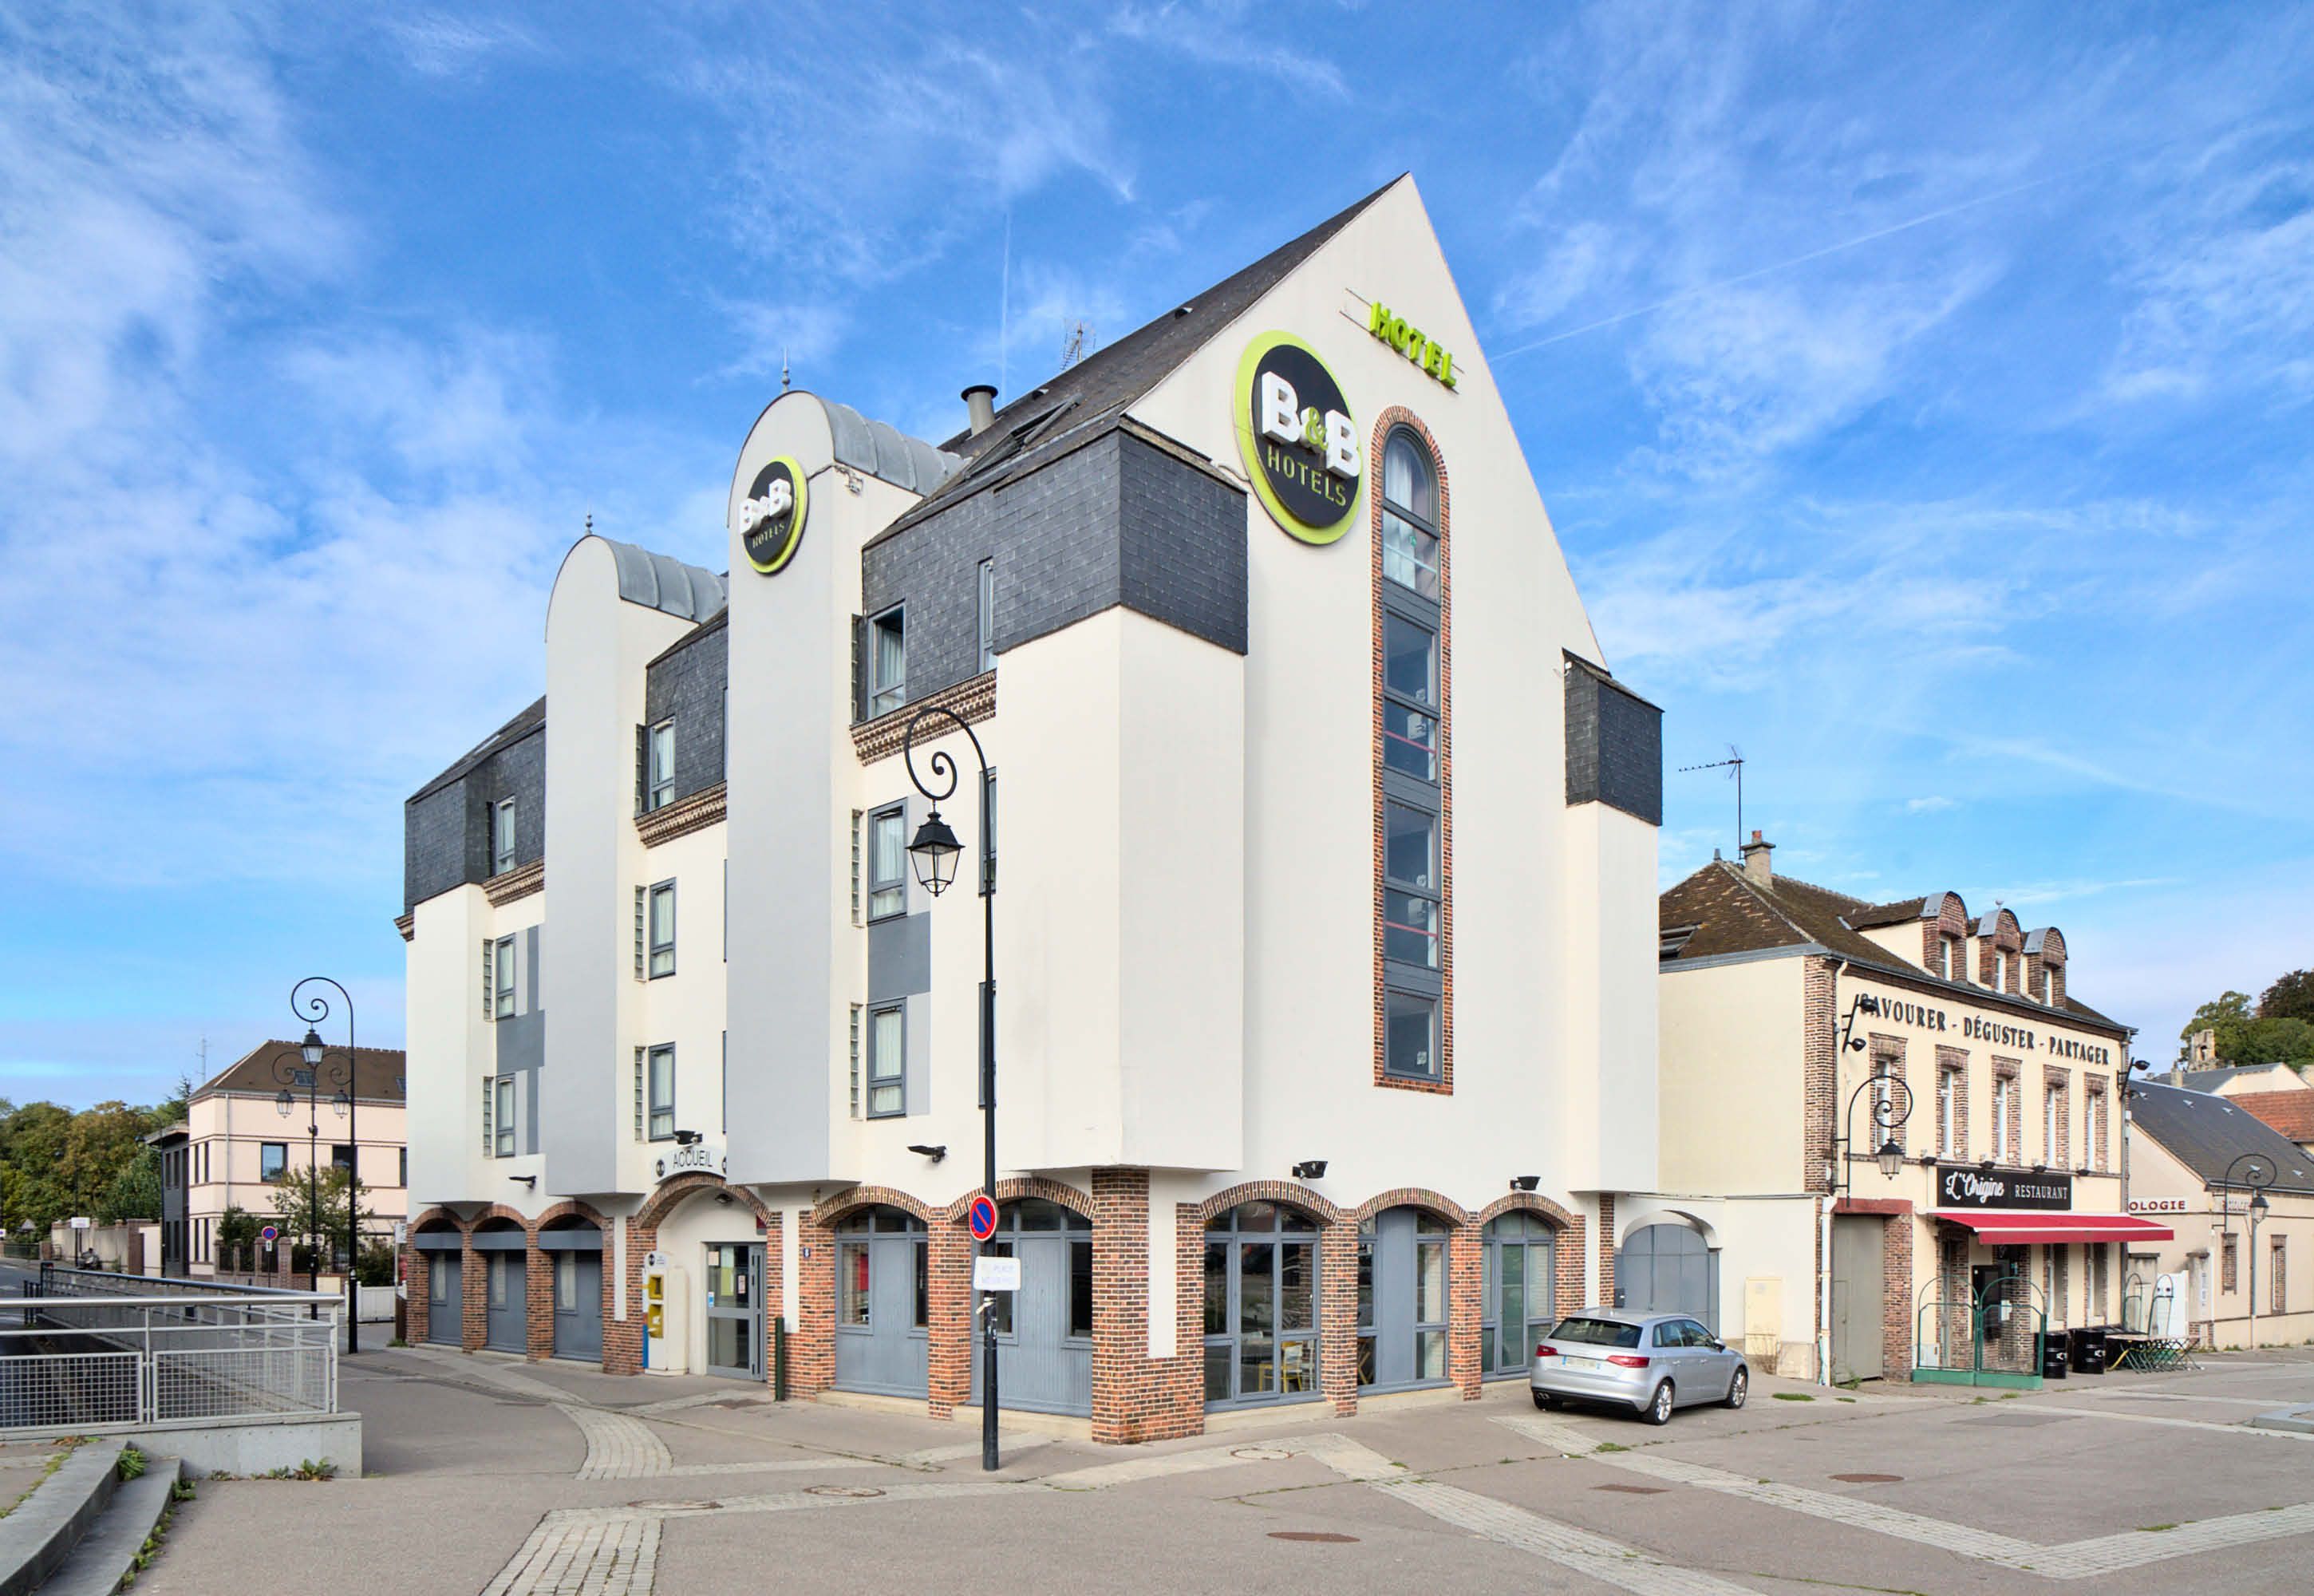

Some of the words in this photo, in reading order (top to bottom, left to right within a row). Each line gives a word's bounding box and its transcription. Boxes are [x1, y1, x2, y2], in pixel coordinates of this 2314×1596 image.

[1369, 301, 1456, 388] HOTEL
[1262, 370, 1362, 480] B&B
[1267, 444, 1347, 508] HOTELS
[752, 523, 785, 549] HOTELS
[1963, 1015, 2035, 1050] DÉGUSTER
[2048, 1036, 2109, 1065] PARTAGER
[673, 1149, 713, 1169] ACCUEIL
[1945, 1171, 2005, 1204] L'Origine
[2014, 1184, 2068, 1200] RESTAURANT
